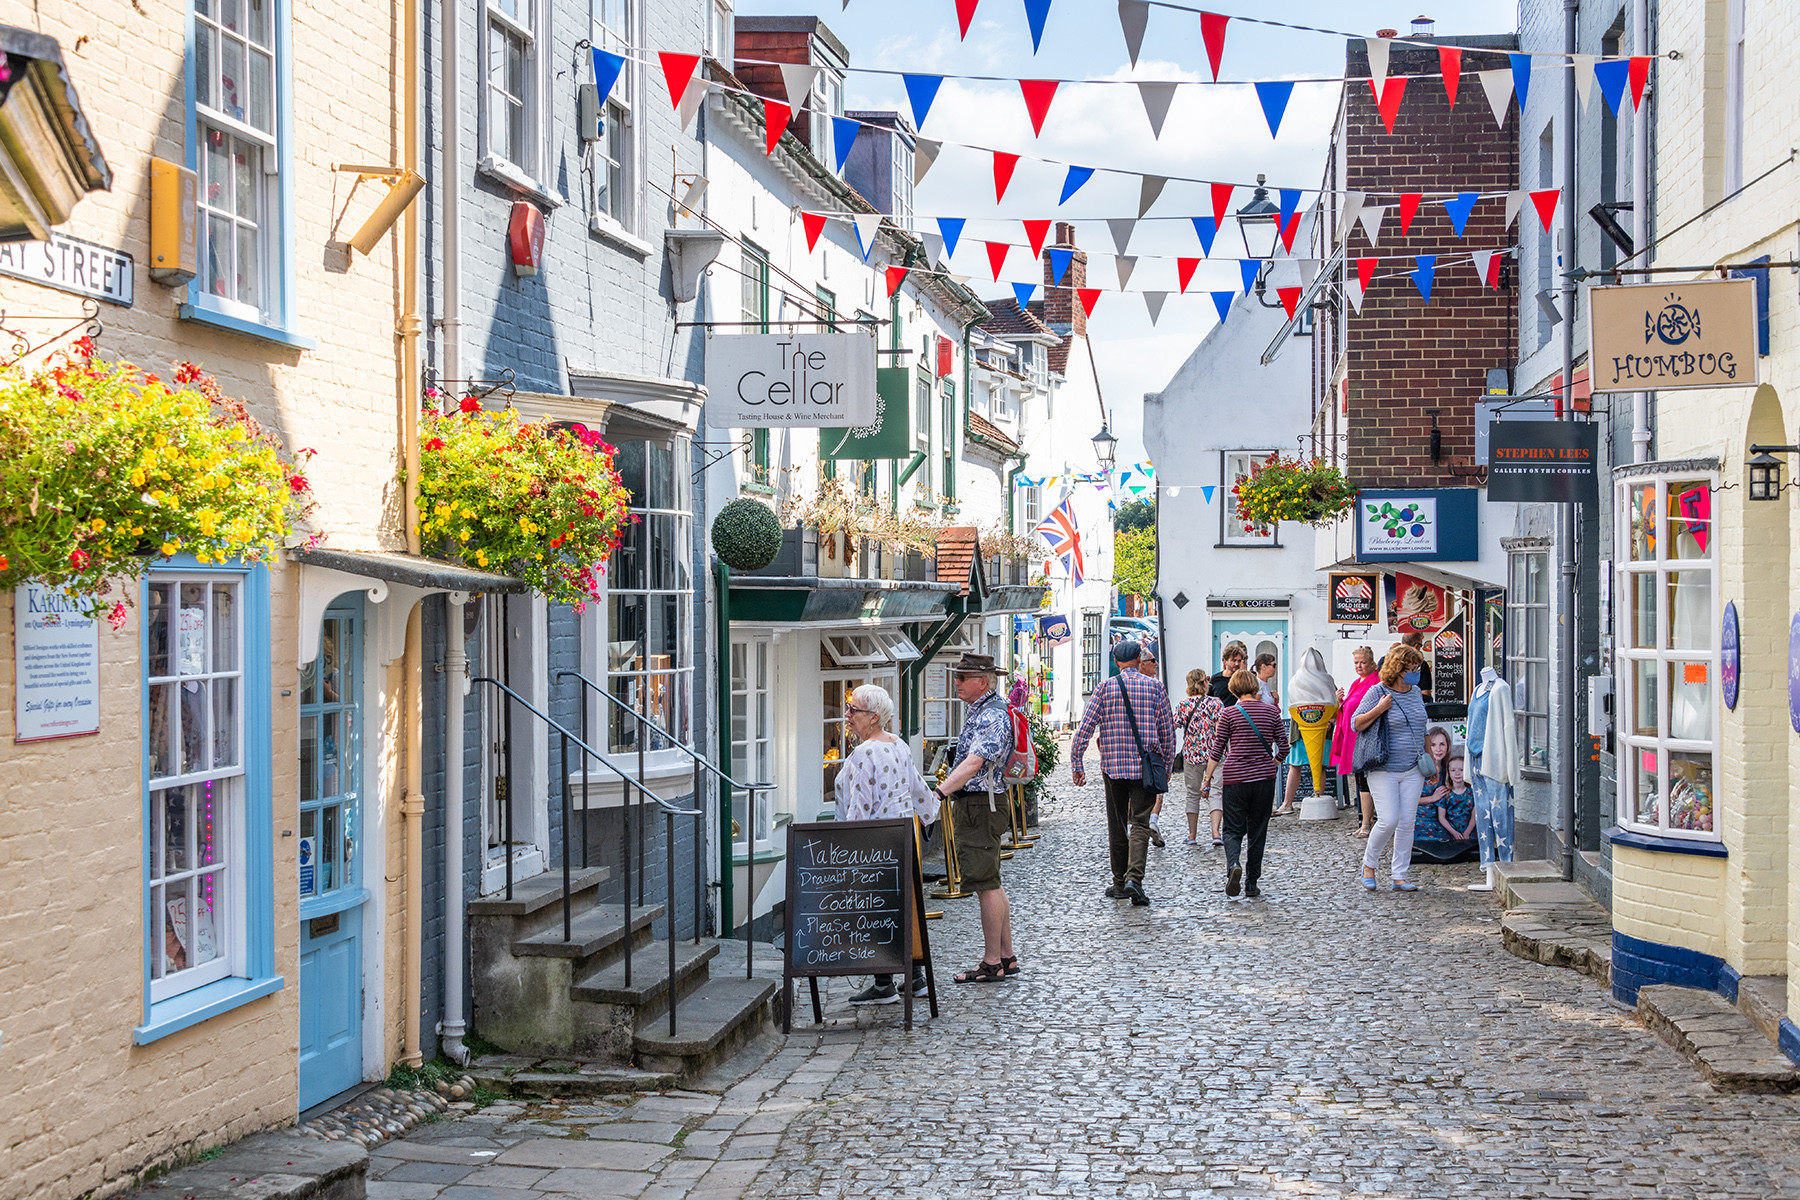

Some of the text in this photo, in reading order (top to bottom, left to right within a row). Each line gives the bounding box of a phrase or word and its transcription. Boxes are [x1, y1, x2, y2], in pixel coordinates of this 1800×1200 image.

[44, 241, 127, 297] STREET
[776, 342, 827, 371] The
[1612, 351, 1737, 384] HUMBUG
[737, 370, 844, 405] Cellar
[737, 413, 762, 421] Tasting
[763, 412, 785, 420] House
[794, 412, 812, 420] Wine
[812, 412, 845, 420] Merchant
[1496, 448, 1590, 459] STEPHEN LEES
[1403, 536, 1430, 545] London
[1437, 661, 1453, 670] Jumbo
[1437, 680, 1456, 688] Coffee
[1437, 688, 1455, 696] Cakes
[802, 839, 899, 866] Takeaway
[800, 869, 884, 888] Draught Beer
[818, 893, 885, 911] Cocktails
[807, 915, 892, 933] Please Queue
[821, 931, 871, 947] on the
[806, 946, 876, 965] Other Side
